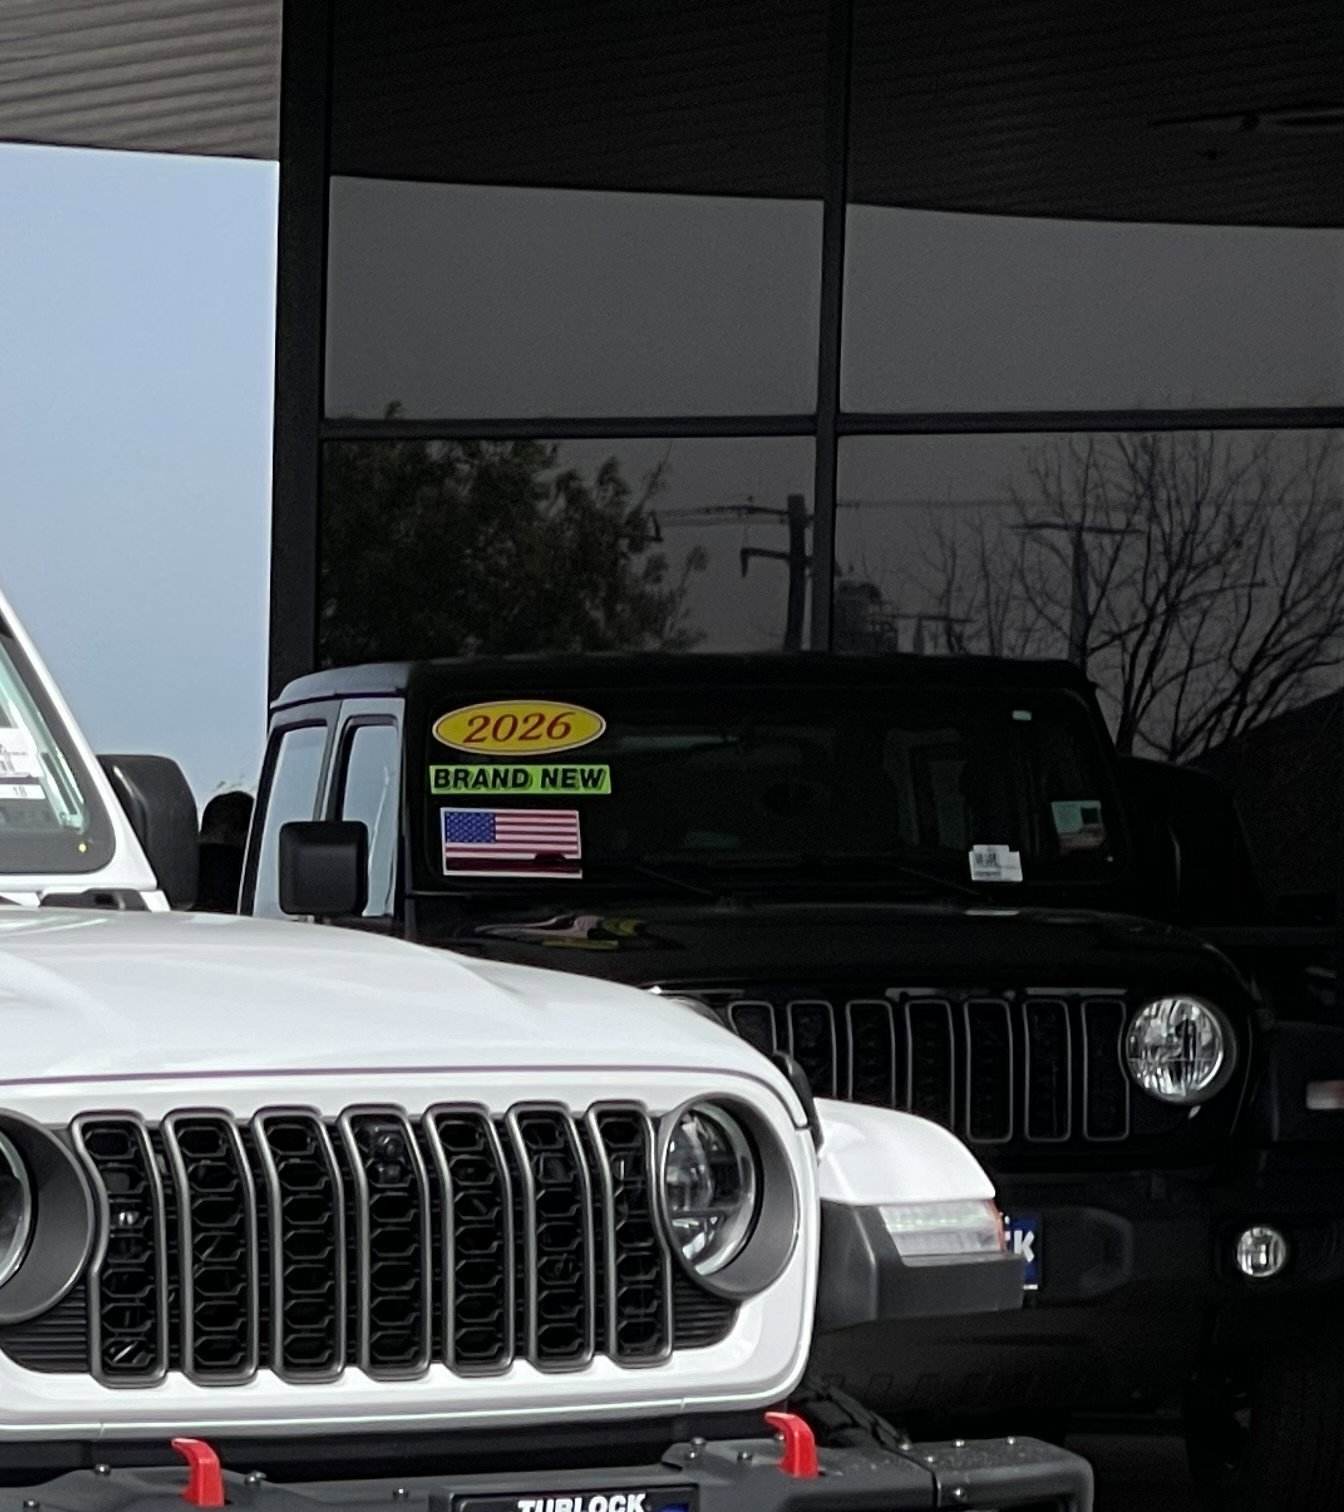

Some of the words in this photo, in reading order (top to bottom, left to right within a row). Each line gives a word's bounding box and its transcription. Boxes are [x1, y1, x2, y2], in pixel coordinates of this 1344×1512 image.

[463, 711, 576, 744] 2026
[433, 767, 531, 791] BRAND
[540, 767, 605, 790] NEW
